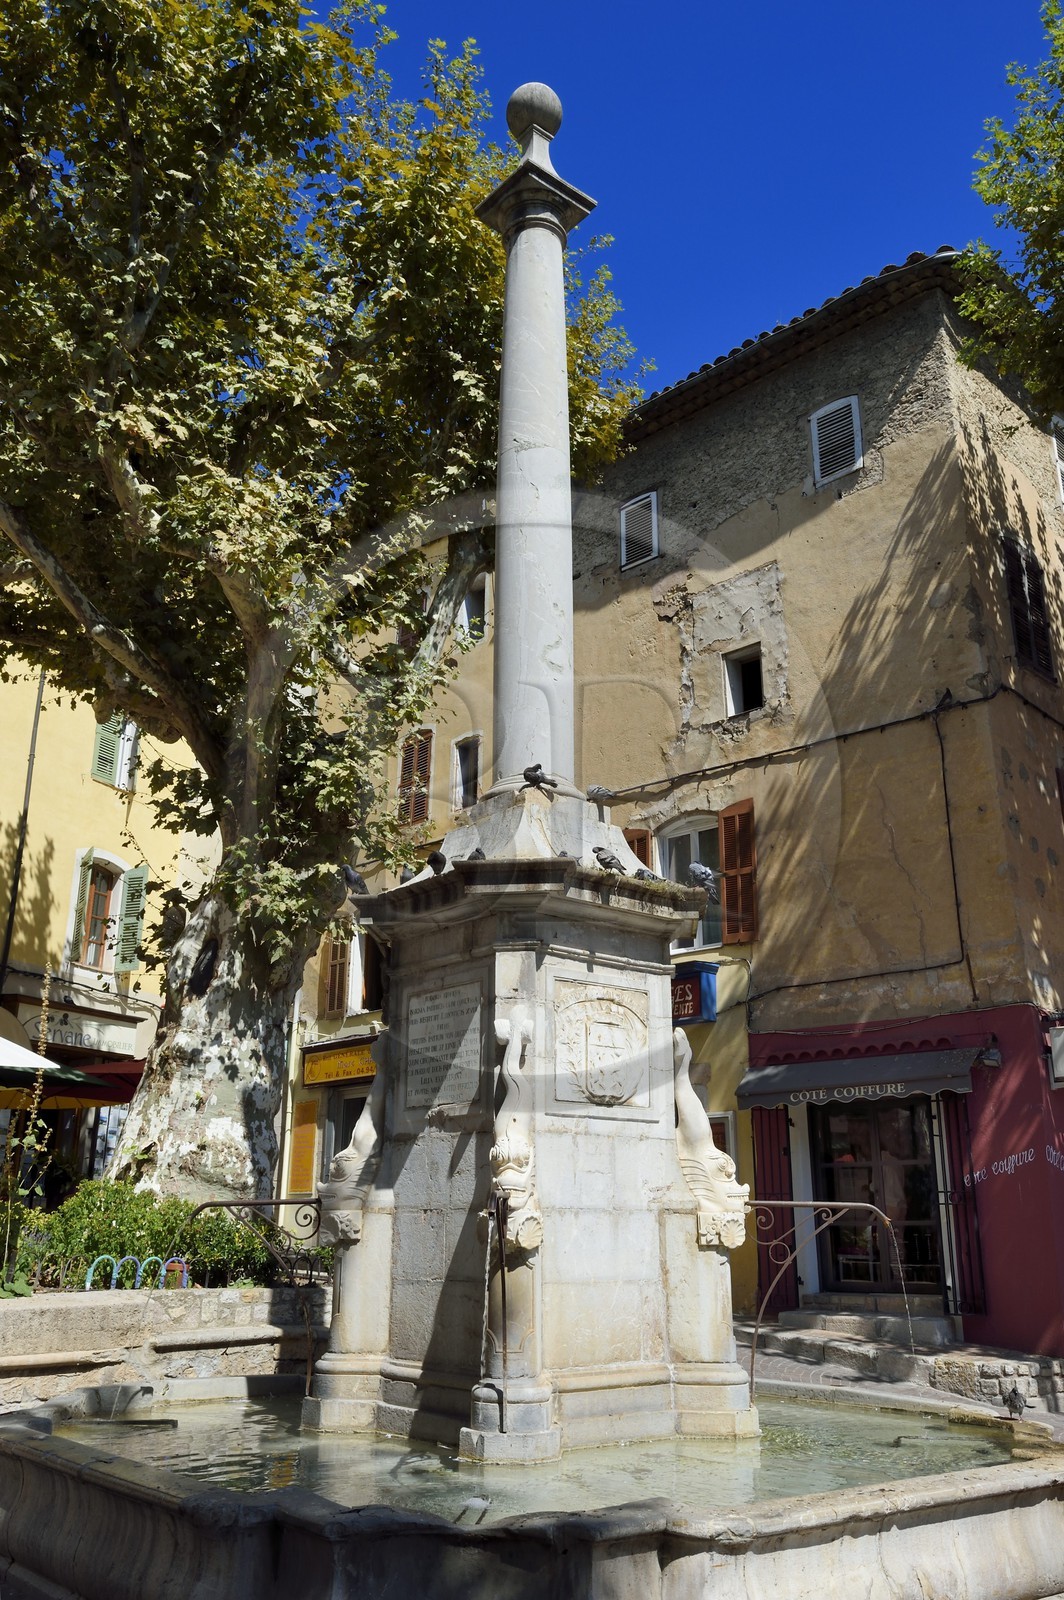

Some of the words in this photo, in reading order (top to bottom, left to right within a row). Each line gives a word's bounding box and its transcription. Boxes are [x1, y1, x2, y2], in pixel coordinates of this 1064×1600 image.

[671, 984, 693, 1003] ES
[673, 1002, 694, 1015] ENTE
[790, 1087, 828, 1102] CÔTÉ
[834, 1082, 906, 1098] COIFFURE
